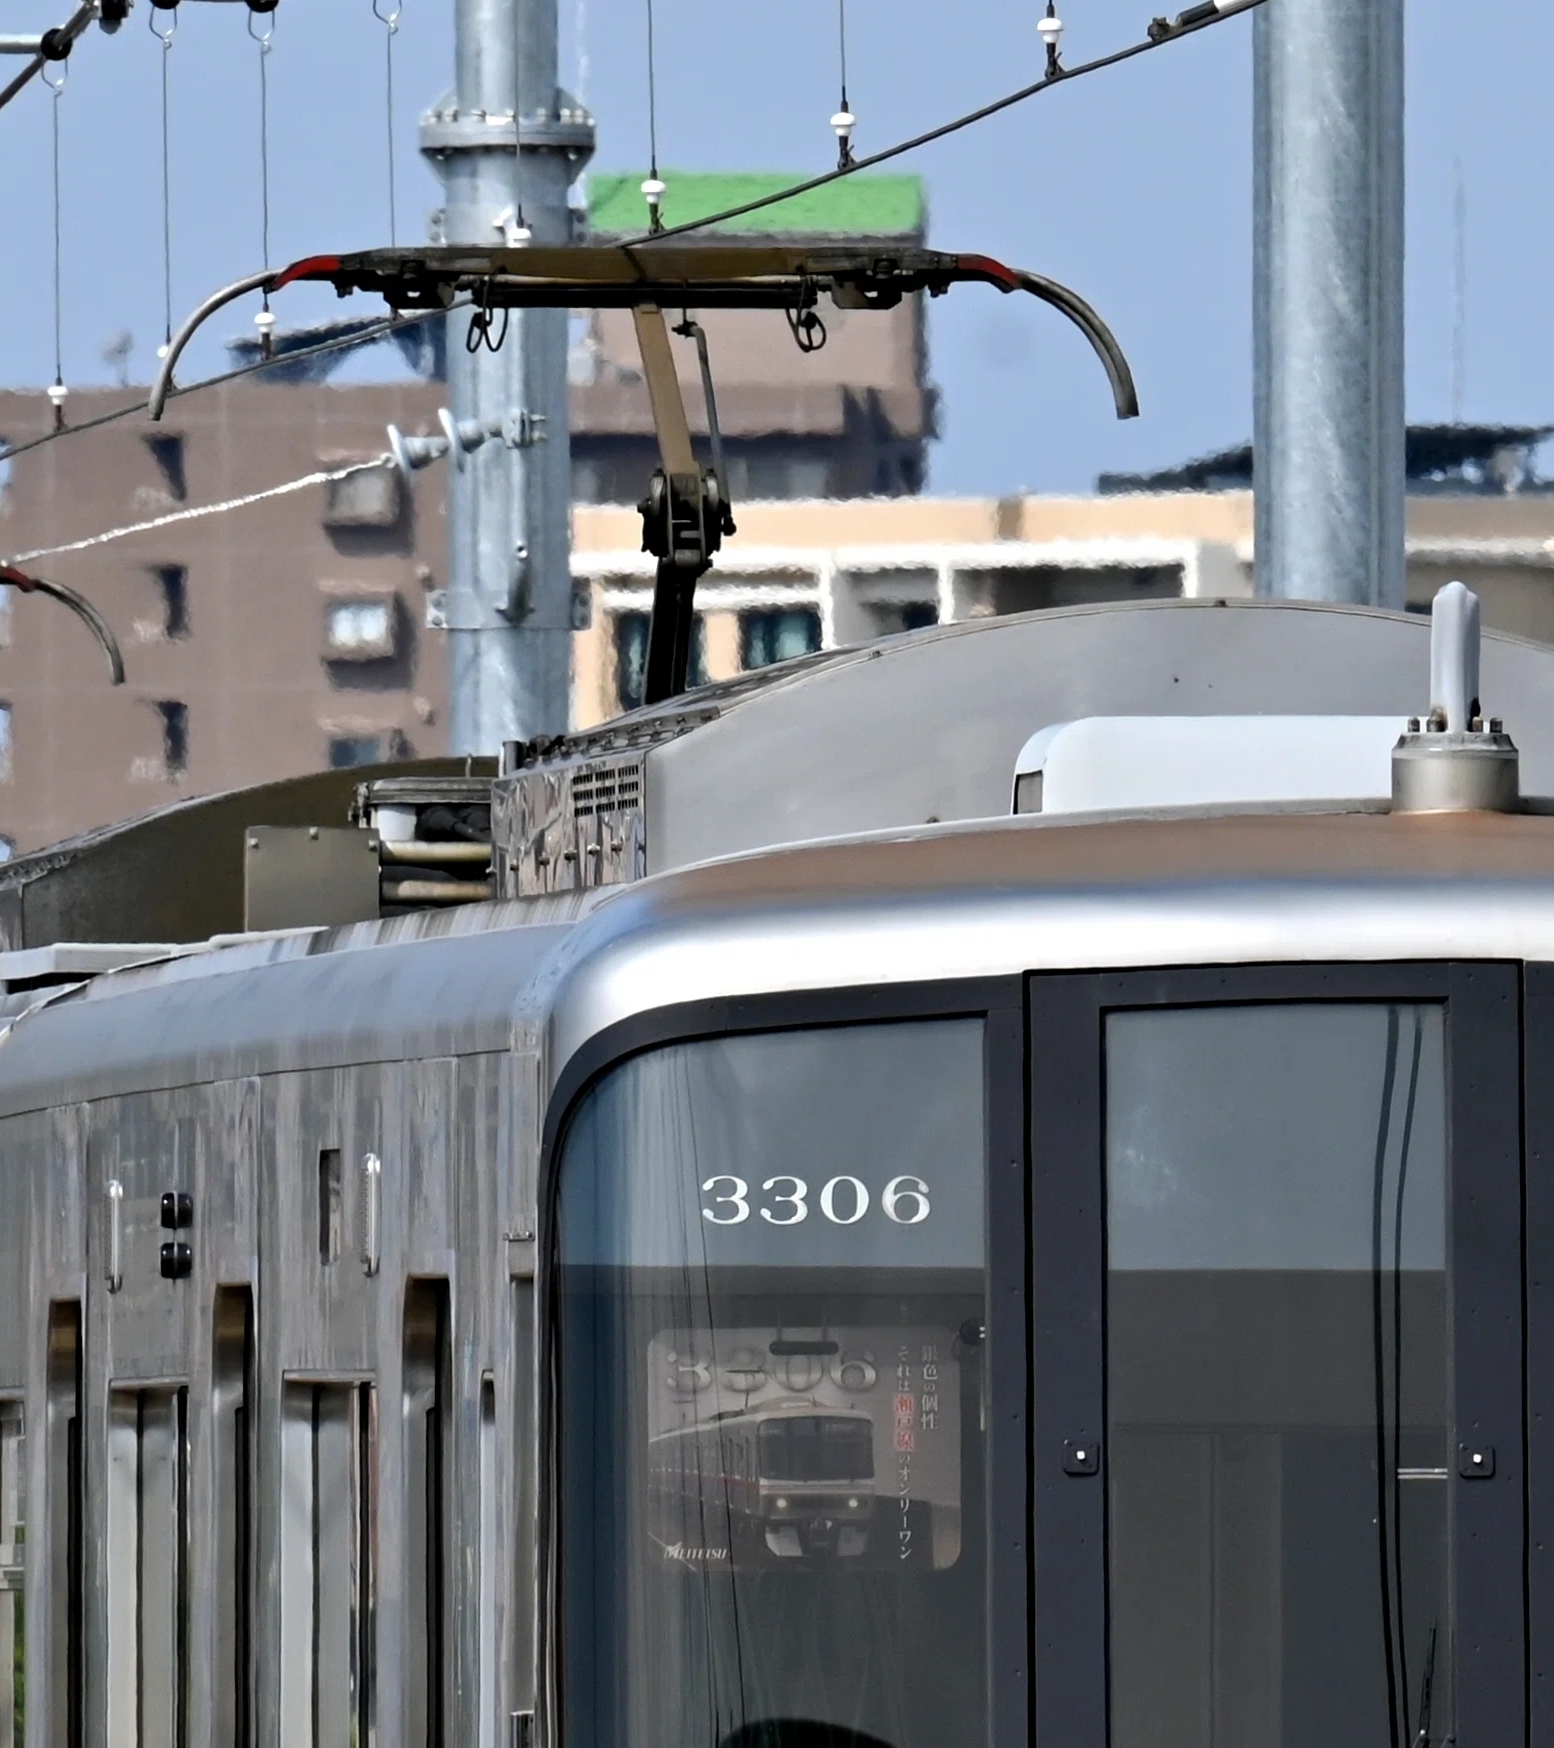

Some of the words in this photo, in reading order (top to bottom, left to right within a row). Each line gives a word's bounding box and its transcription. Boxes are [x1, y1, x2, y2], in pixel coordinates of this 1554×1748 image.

[702, 1174, 931, 1226] 3306
[921, 1345, 939, 1431] 銀色の個性
